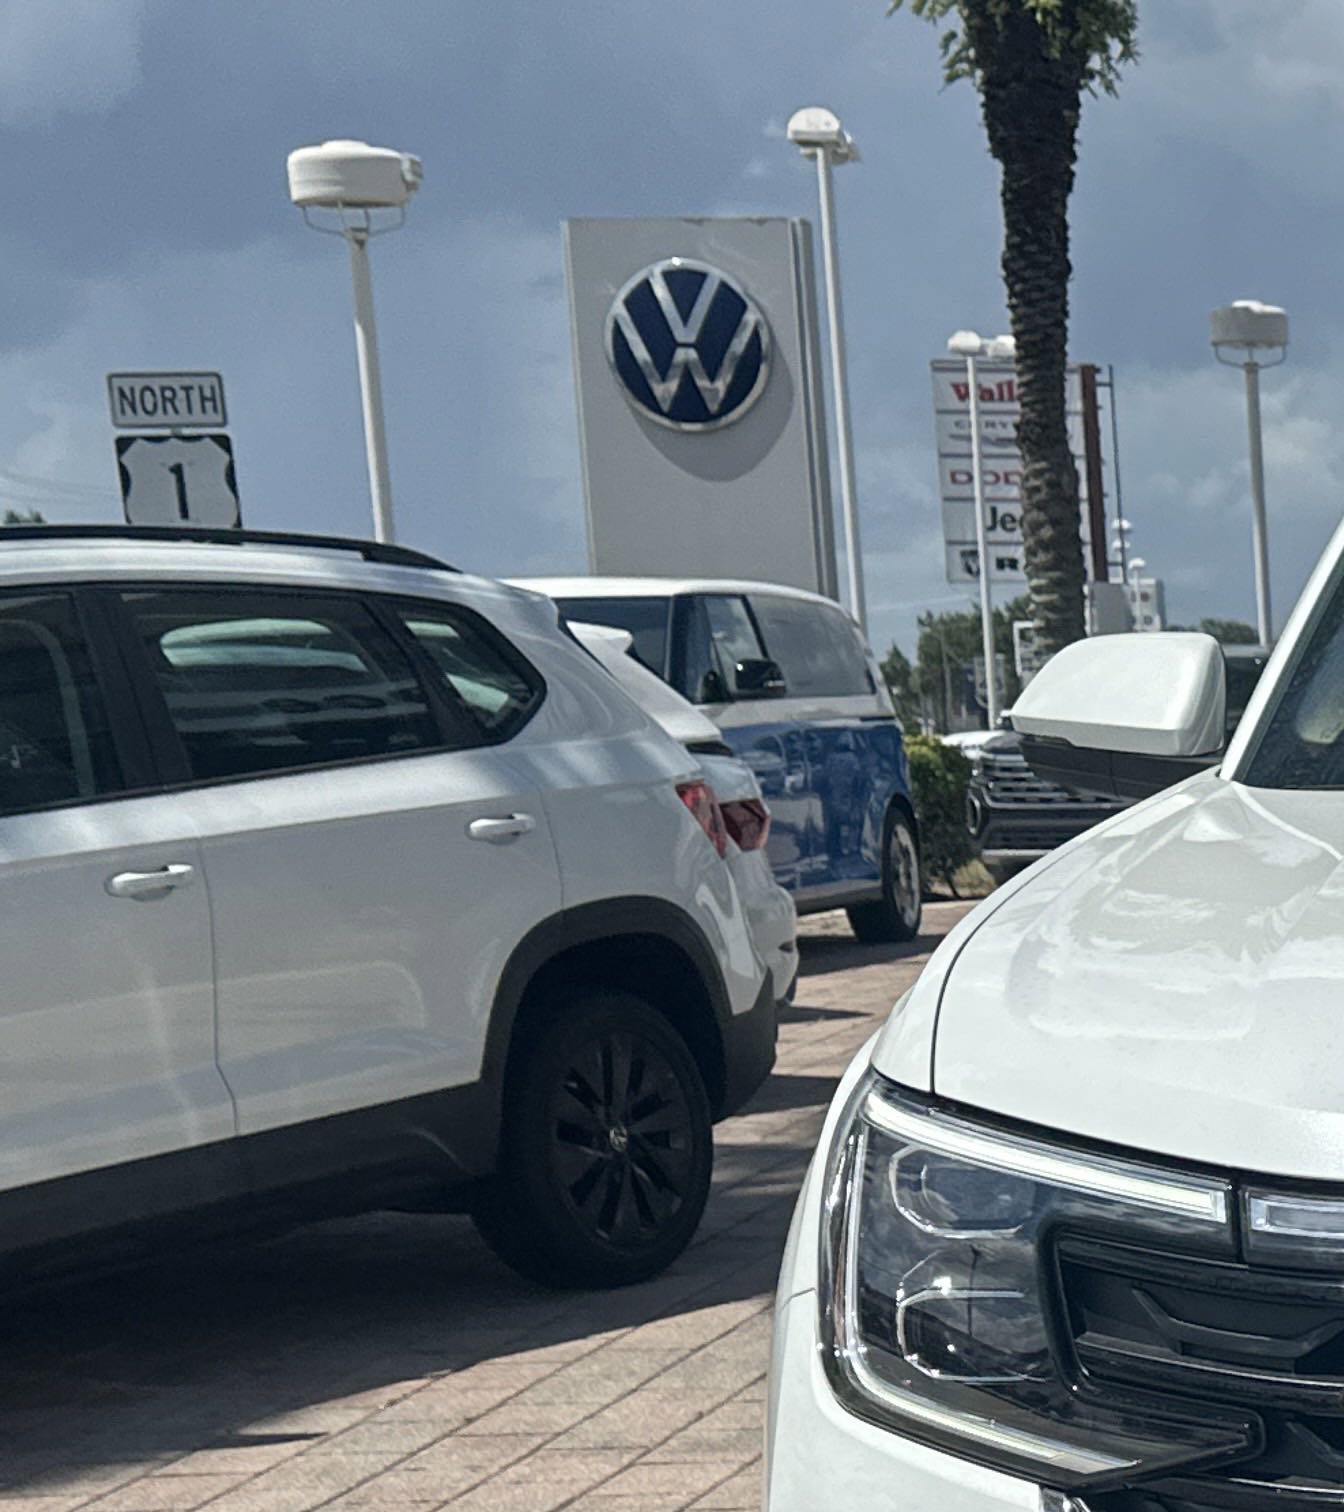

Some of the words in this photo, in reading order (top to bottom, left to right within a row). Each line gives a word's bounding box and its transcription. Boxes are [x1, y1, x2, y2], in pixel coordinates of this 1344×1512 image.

[604, 257, 770, 431] VW
[117, 384, 219, 416] NORTH
[951, 379, 1022, 401] Wall
[168, 462, 189, 520] 1
[950, 470, 1022, 486] DOD
